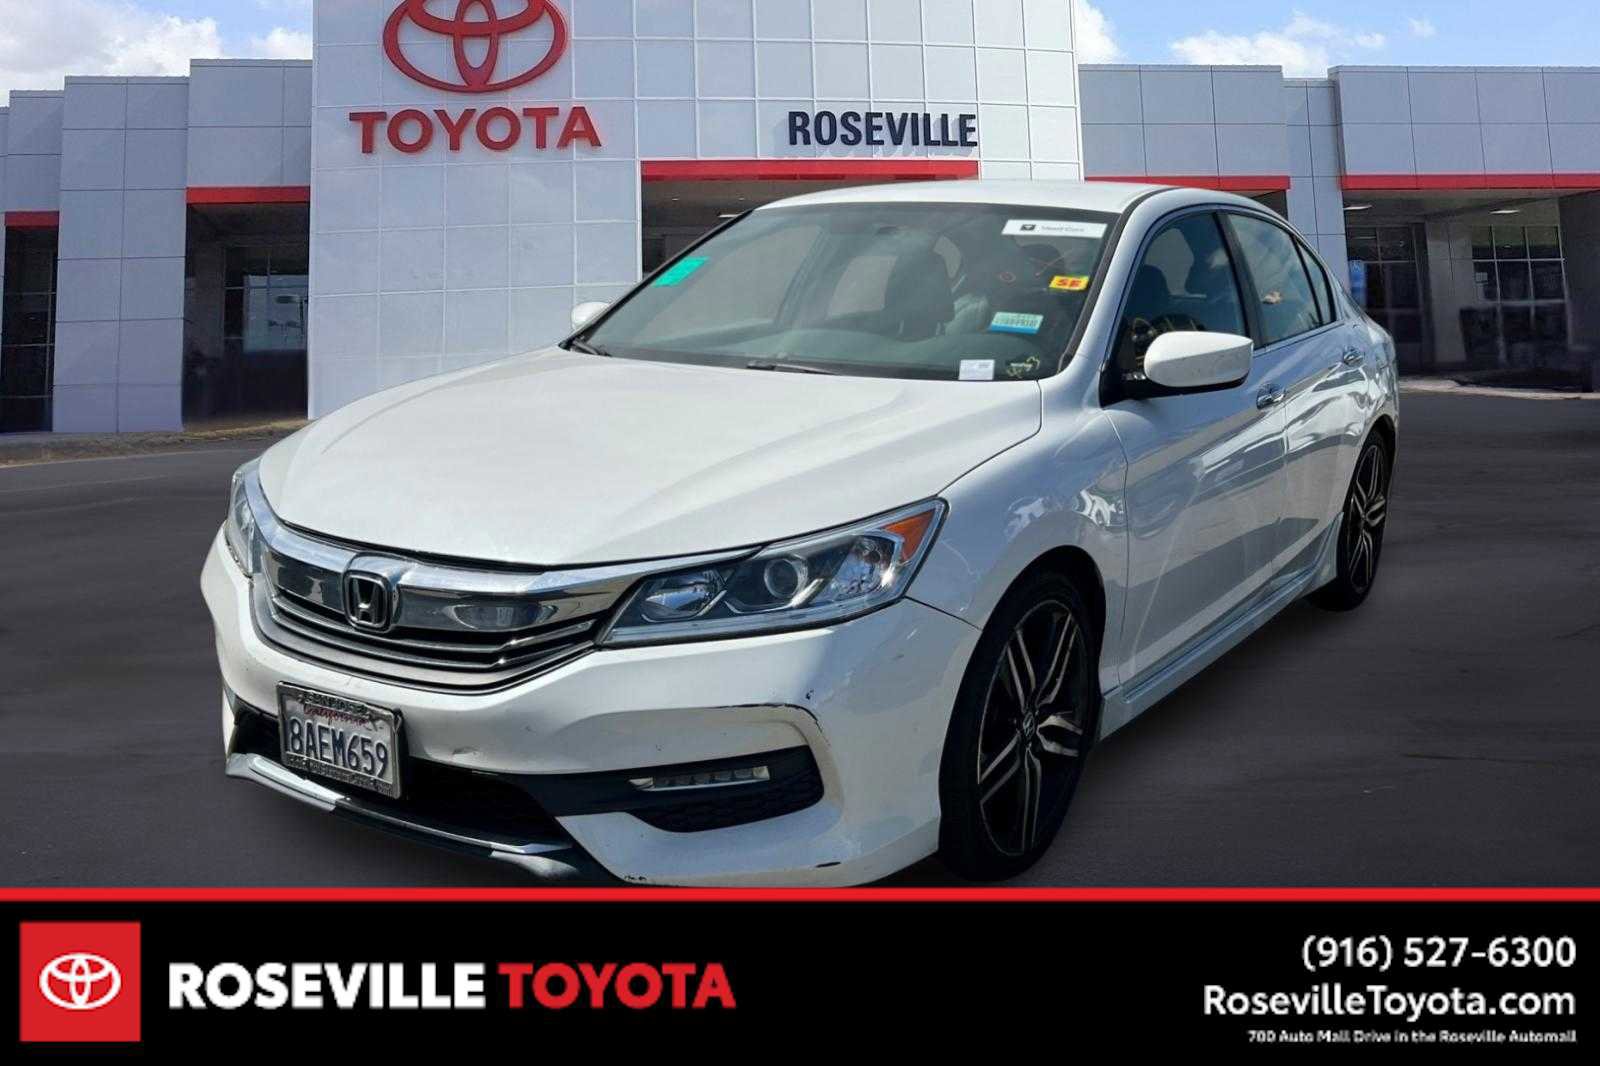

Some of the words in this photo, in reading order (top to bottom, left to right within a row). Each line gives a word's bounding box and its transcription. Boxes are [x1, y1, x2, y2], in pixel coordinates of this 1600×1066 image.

[349, 105, 602, 154] TOYOTA
[788, 110, 978, 147] ROSEVILLE
[290, 717, 388, 778] 8AEM659
